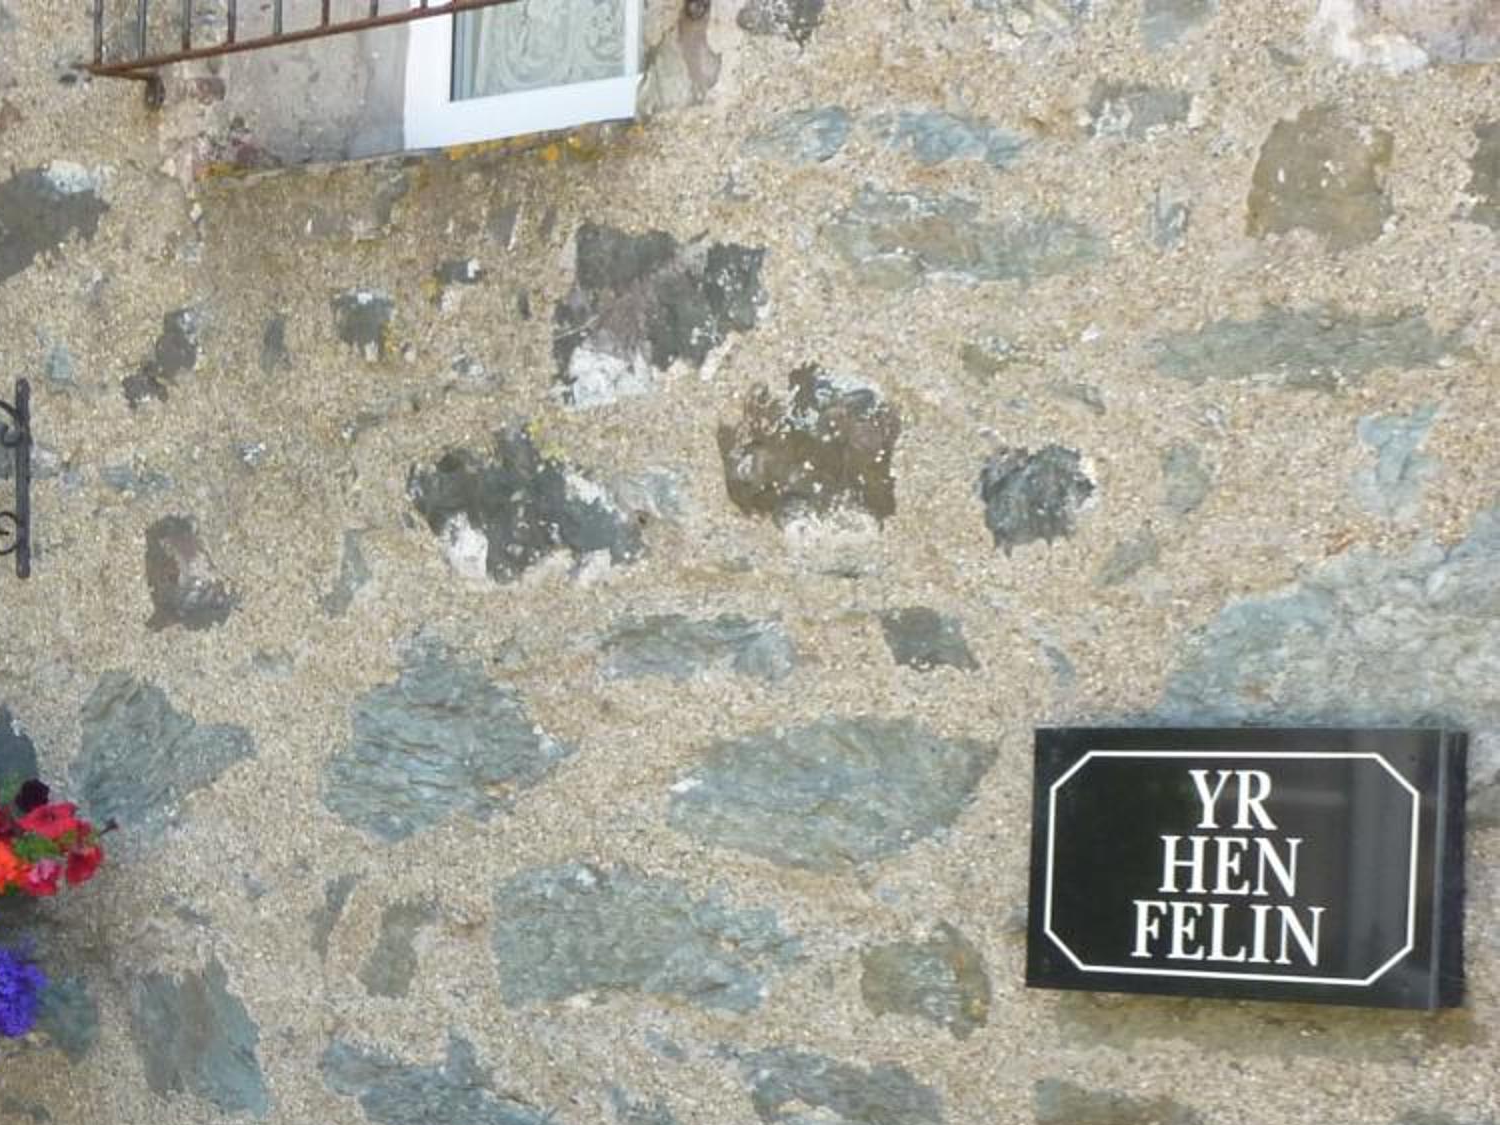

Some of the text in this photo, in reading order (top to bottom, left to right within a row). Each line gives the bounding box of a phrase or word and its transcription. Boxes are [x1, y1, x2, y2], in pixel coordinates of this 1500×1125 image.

[1188, 769, 1278, 831] YR
[1158, 835, 1303, 897] HEN
[1130, 899, 1326, 967] FELIN
